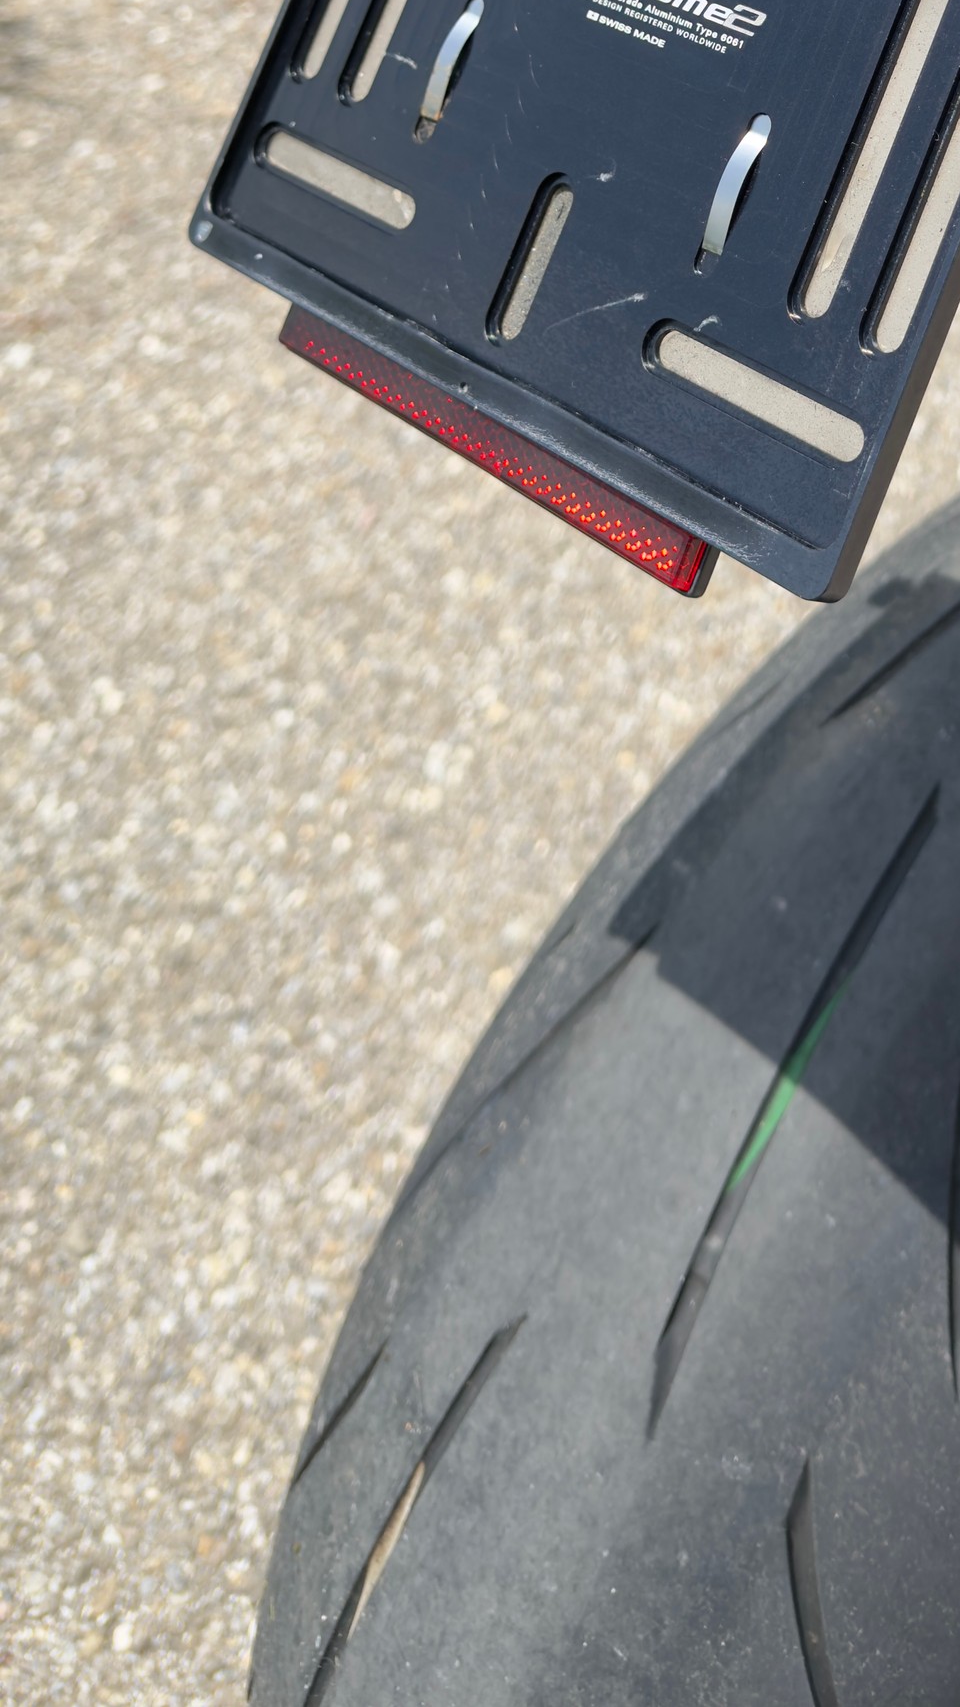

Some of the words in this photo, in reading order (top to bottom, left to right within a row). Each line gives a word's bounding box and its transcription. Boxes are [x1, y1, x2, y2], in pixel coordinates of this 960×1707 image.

[598, 15, 632, 35] SWISS
[633, 28, 667, 49] MADE
[624, 7, 674, 32] REGISTERED
[675, 27, 727, 54] WORLDWIDE
[644, 4, 693, 29] Aluminium
[695, 23, 718, 40] Type
[720, 33, 744, 49] 6061
